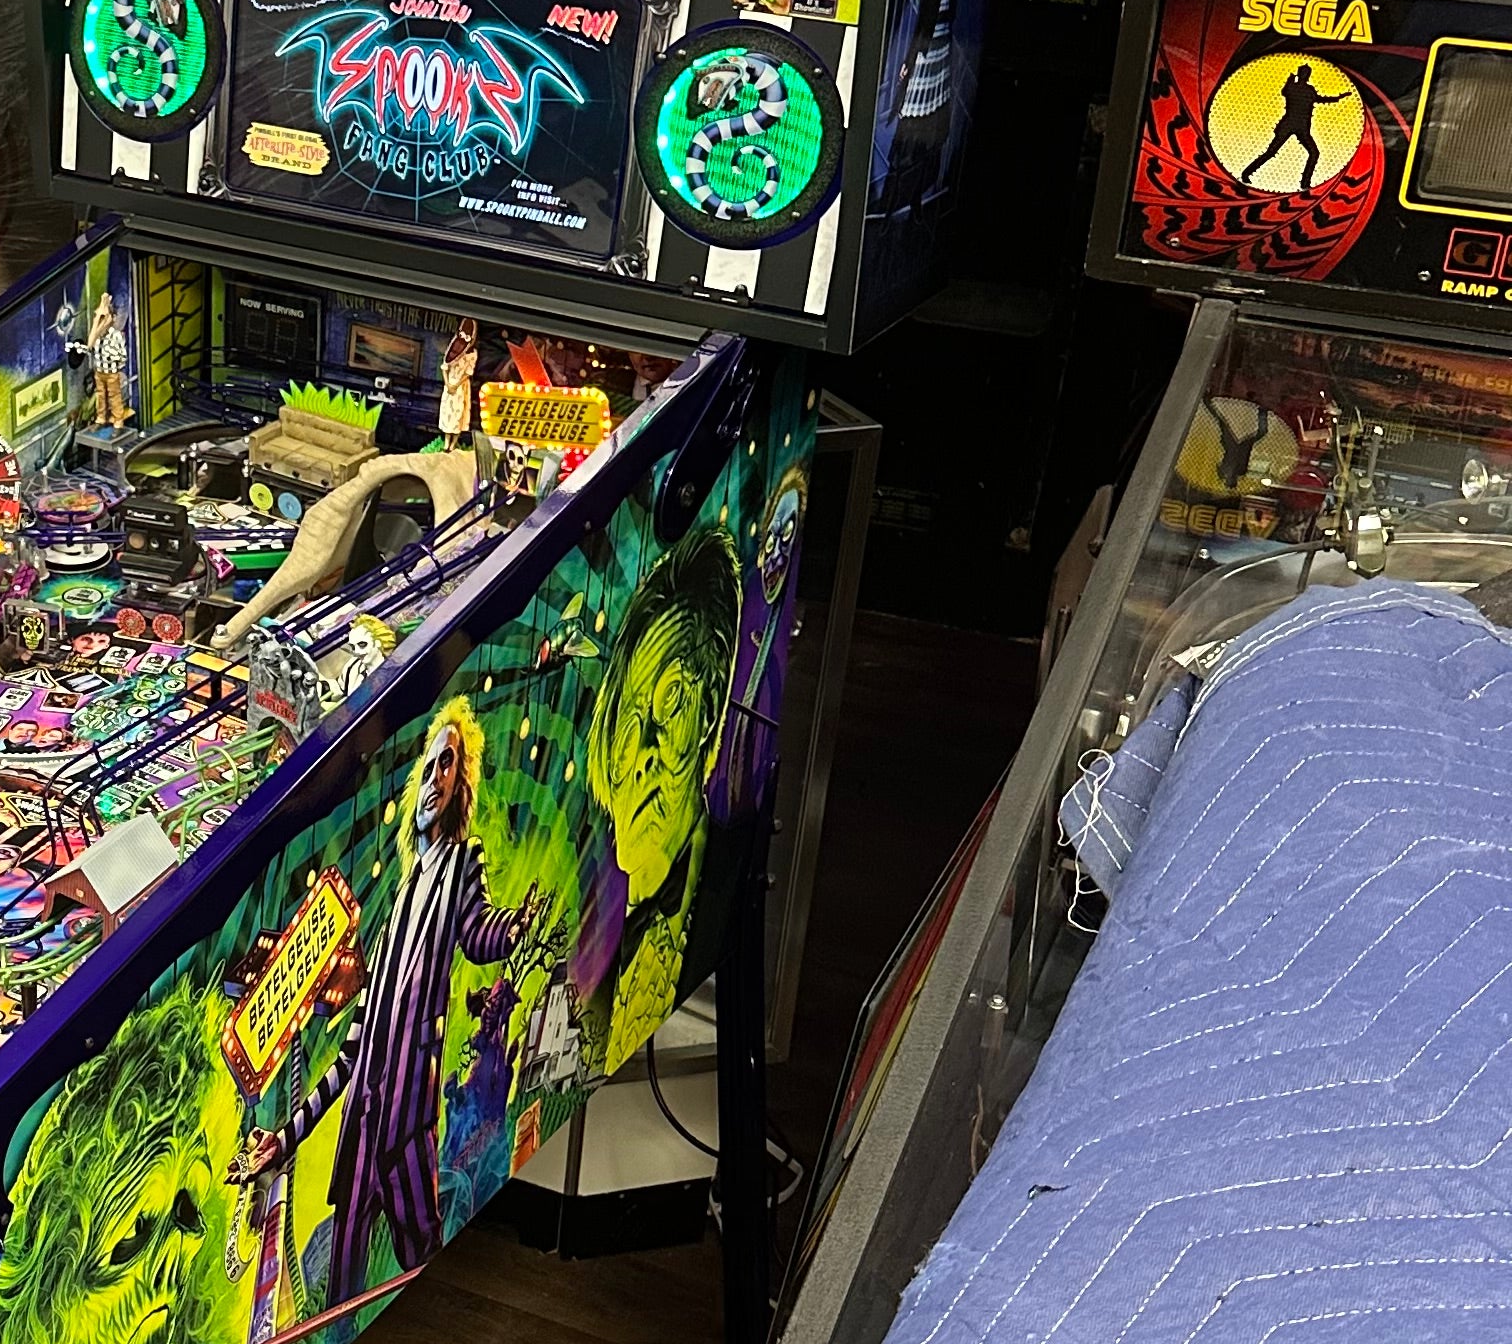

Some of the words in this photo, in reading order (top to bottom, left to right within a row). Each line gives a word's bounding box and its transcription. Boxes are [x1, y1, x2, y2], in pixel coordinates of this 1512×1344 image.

[547, 4, 619, 45] NEW!
[322, 16, 524, 155] SPOOKY
[261, 153, 313, 170] BRAND
[343, 121, 408, 180] FANG
[423, 144, 488, 183] CLUB
[510, 179, 527, 191] FOR
[528, 181, 554, 194] MORE
[1441, 279, 1499, 298] RAMP
[240, 296, 262, 311] NOW
[265, 302, 306, 319] SERVING
[495, 397, 588, 421] BETELGEUSE
[497, 418, 590, 441] BETELGEUSE
[249, 895, 327, 1034] BETELGEUSE
[256, 912, 337, 1054] BETELGEUSE
